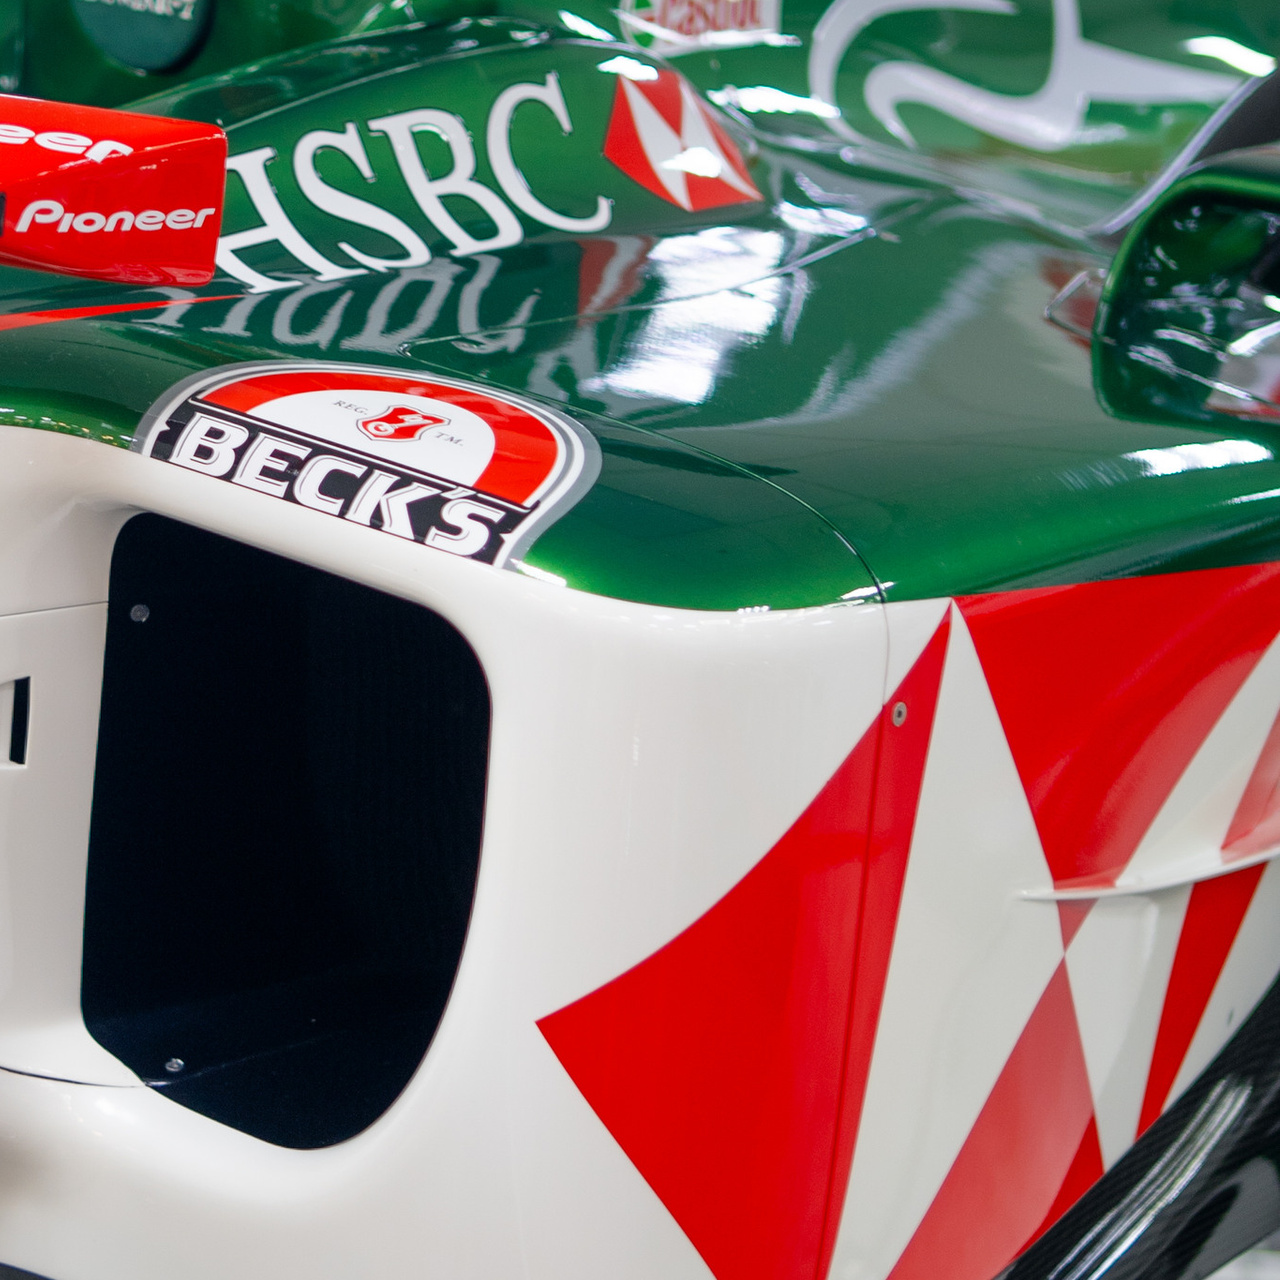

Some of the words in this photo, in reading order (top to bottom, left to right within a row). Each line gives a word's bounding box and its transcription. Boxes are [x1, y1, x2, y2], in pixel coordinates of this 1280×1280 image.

[15, 199, 216, 234] Pioneer
[214, 70, 616, 294] HSBC
[169, 410, 507, 557] BECK'S
